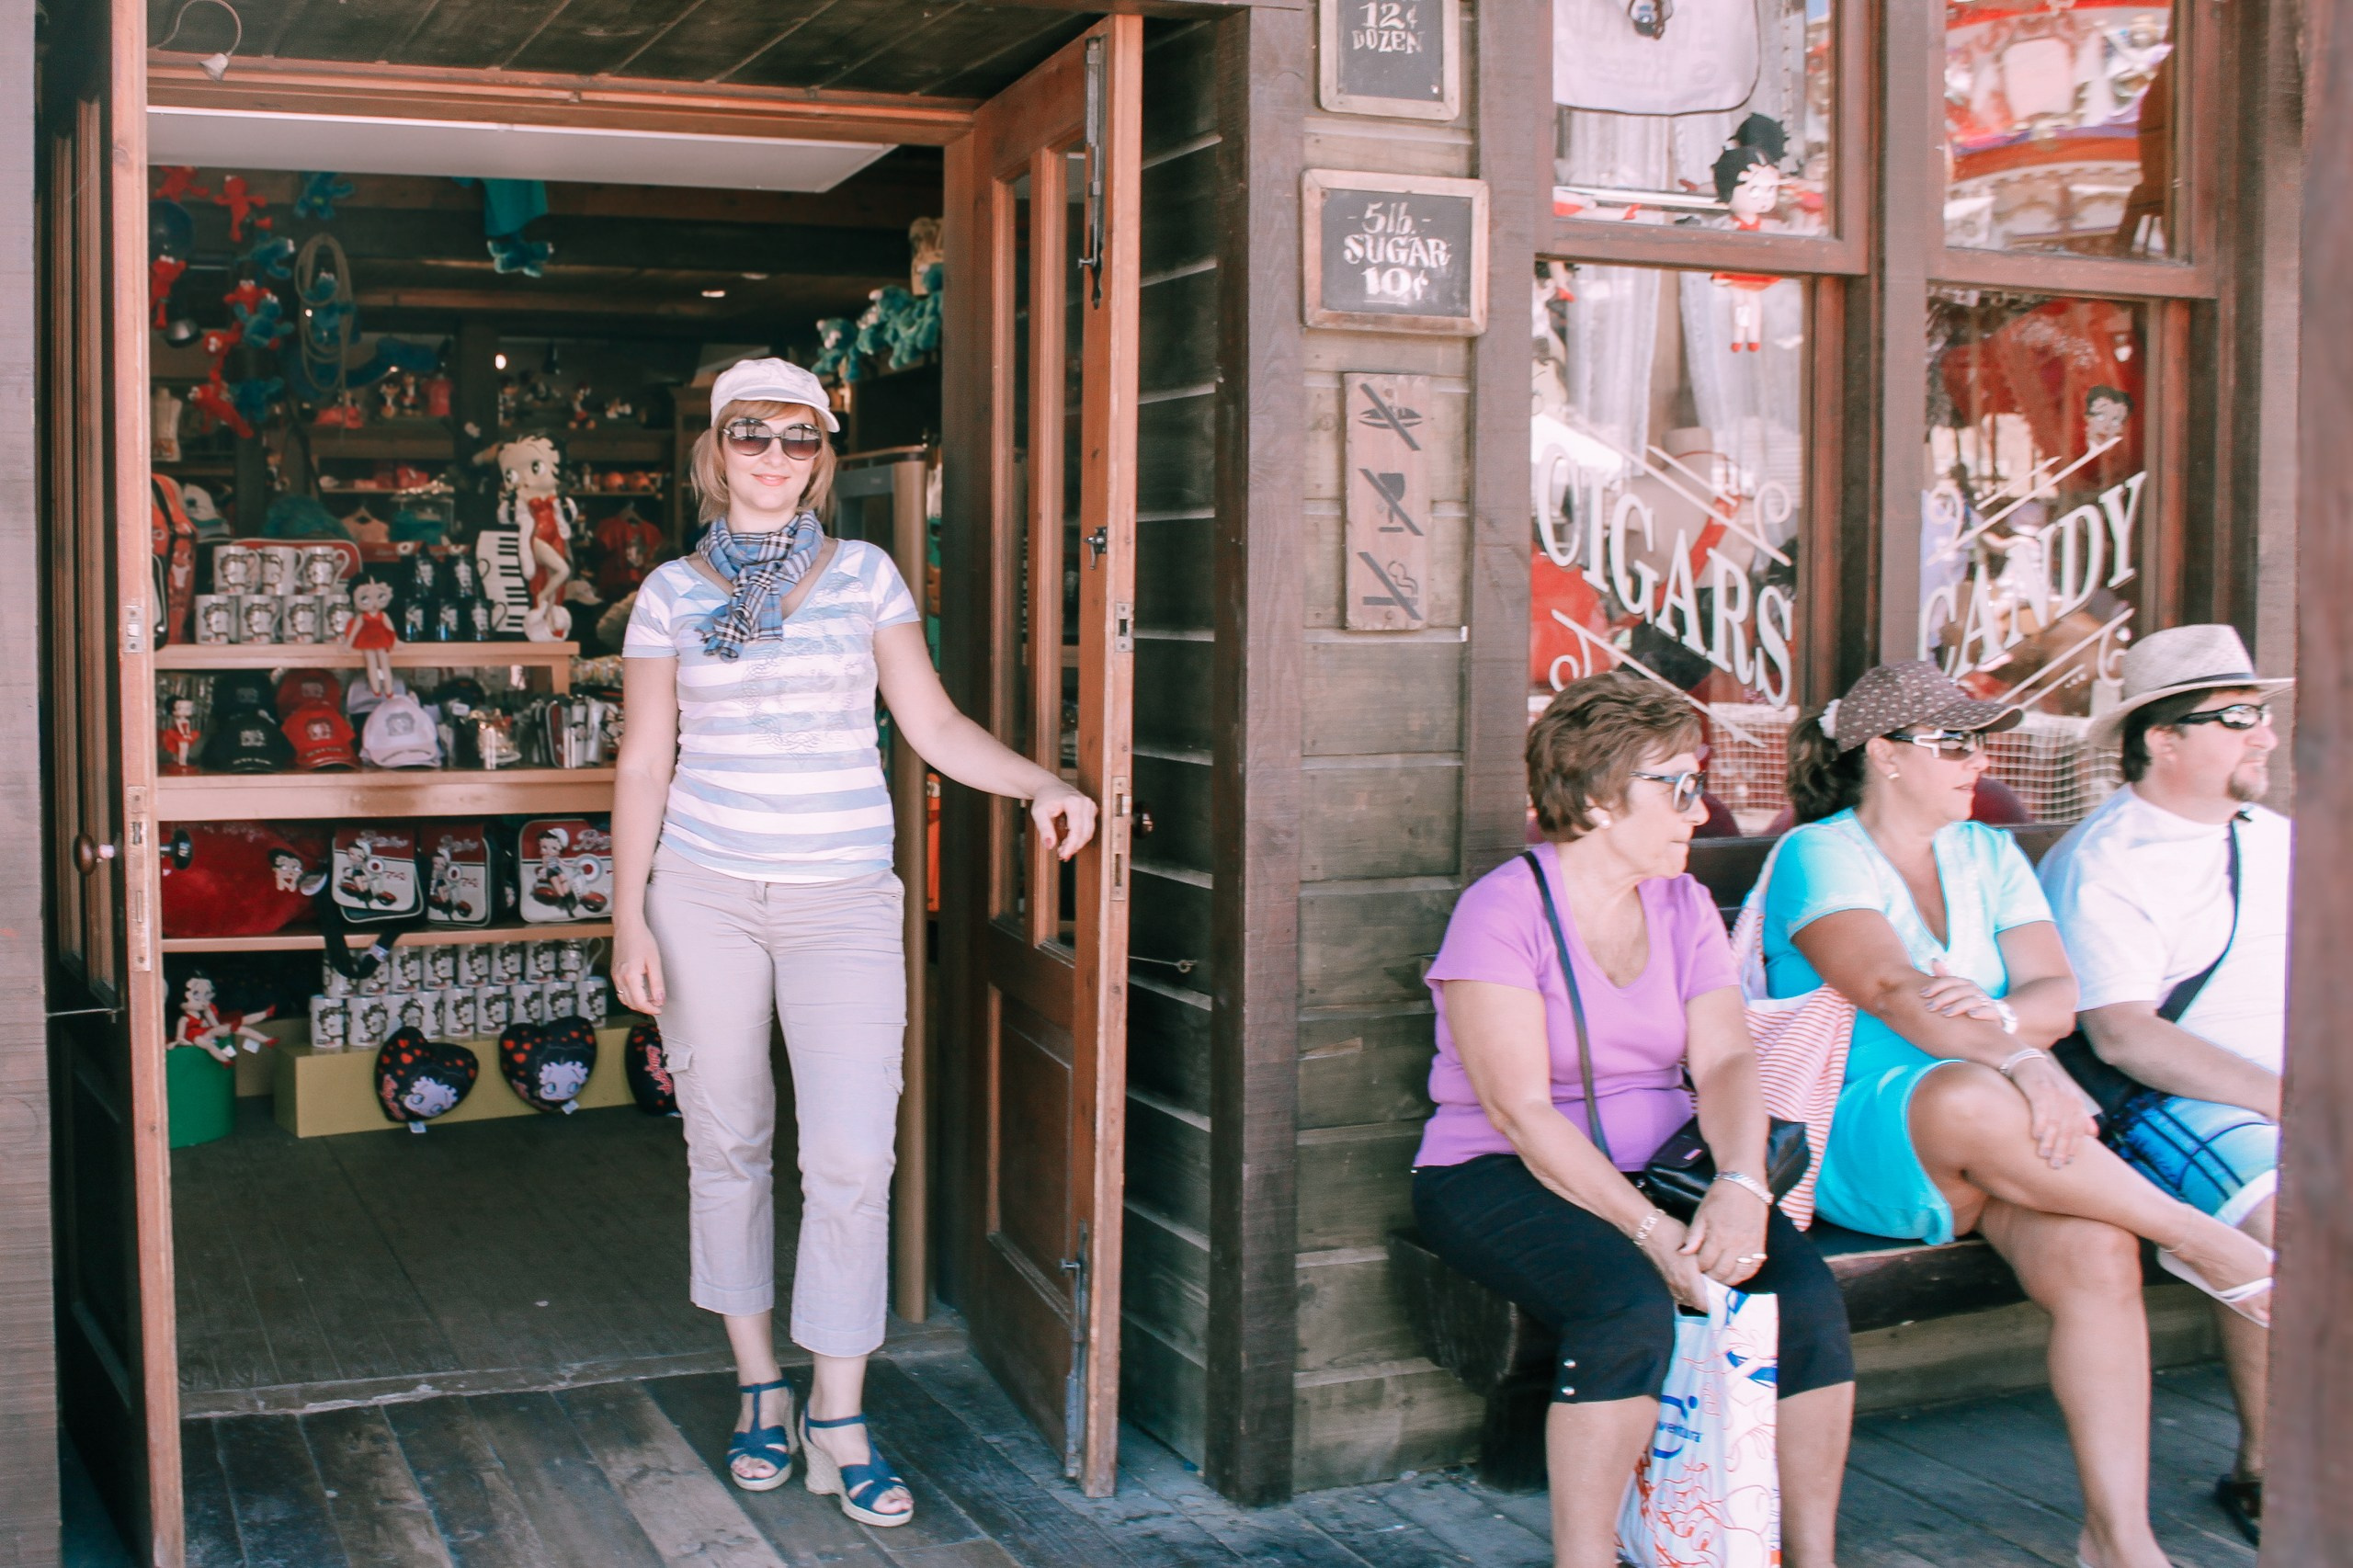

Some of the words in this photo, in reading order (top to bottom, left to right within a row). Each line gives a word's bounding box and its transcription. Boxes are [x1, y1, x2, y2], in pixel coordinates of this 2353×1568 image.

[1351, 28, 1426, 54] DOZEN
[1343, 234, 1452, 267] SUGAR
[1536, 443, 1794, 707] CIGARS
[1917, 471, 2147, 680] CANDY
